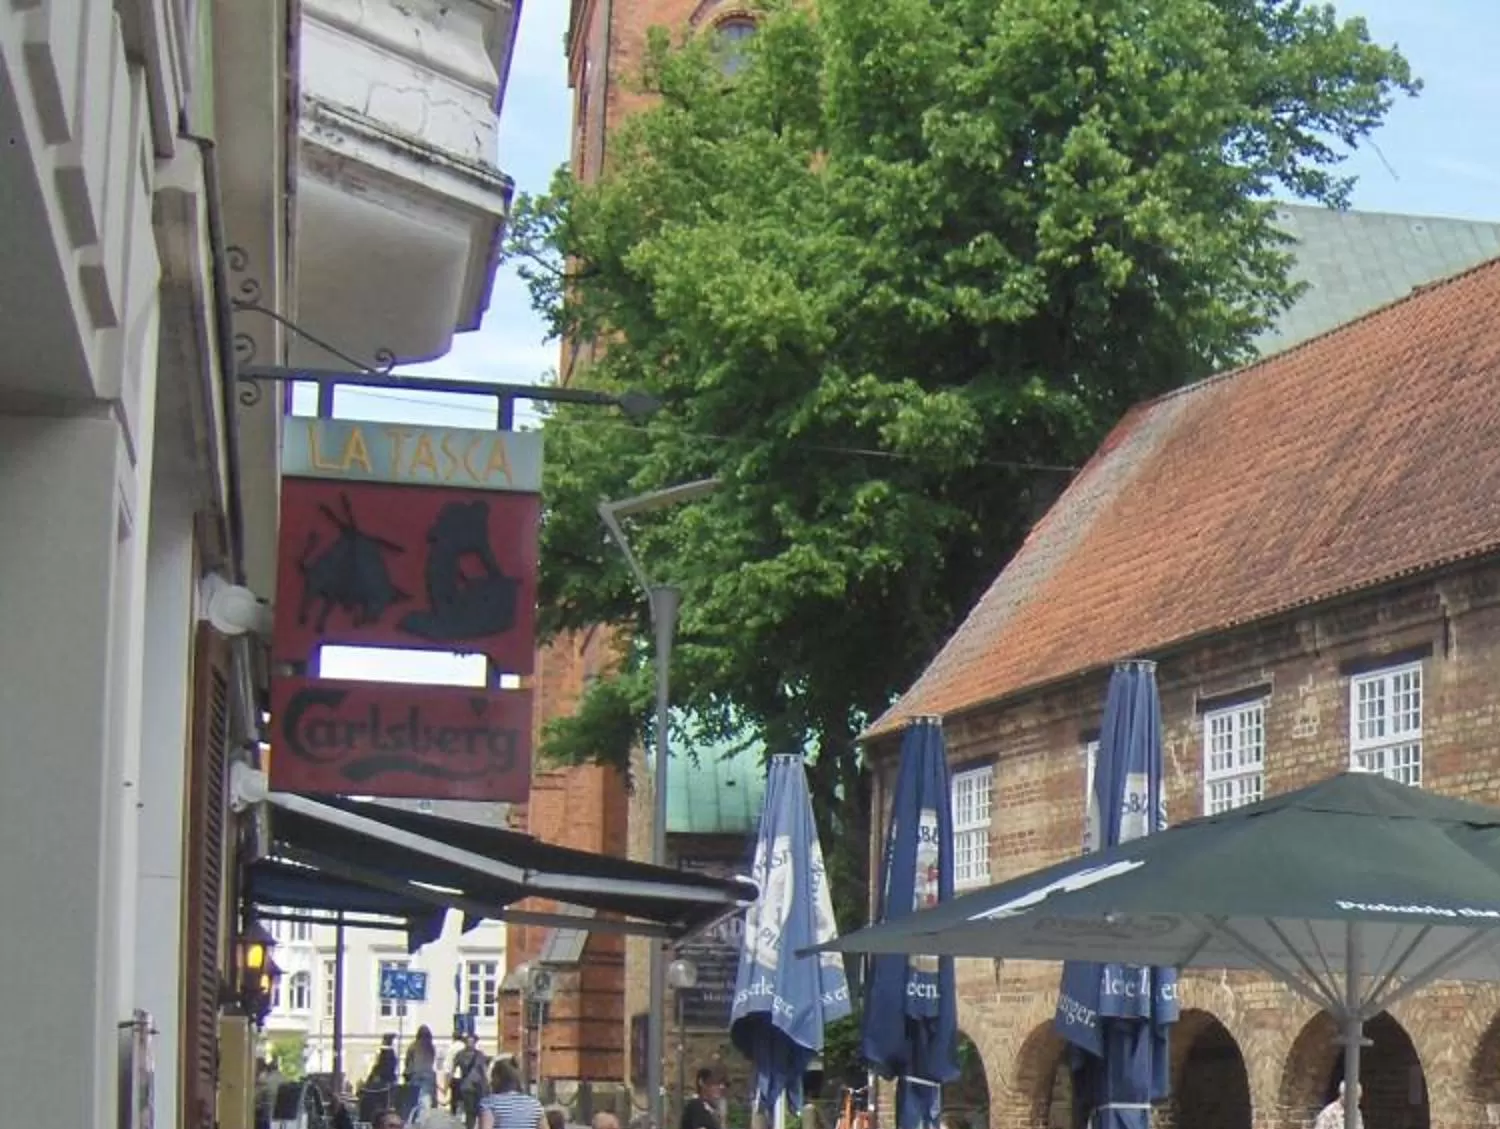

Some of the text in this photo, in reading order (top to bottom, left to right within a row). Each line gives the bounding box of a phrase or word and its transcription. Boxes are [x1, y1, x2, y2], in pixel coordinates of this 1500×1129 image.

[307, 425, 515, 485] LA TASCA
[281, 689, 520, 773] Carlsberg
